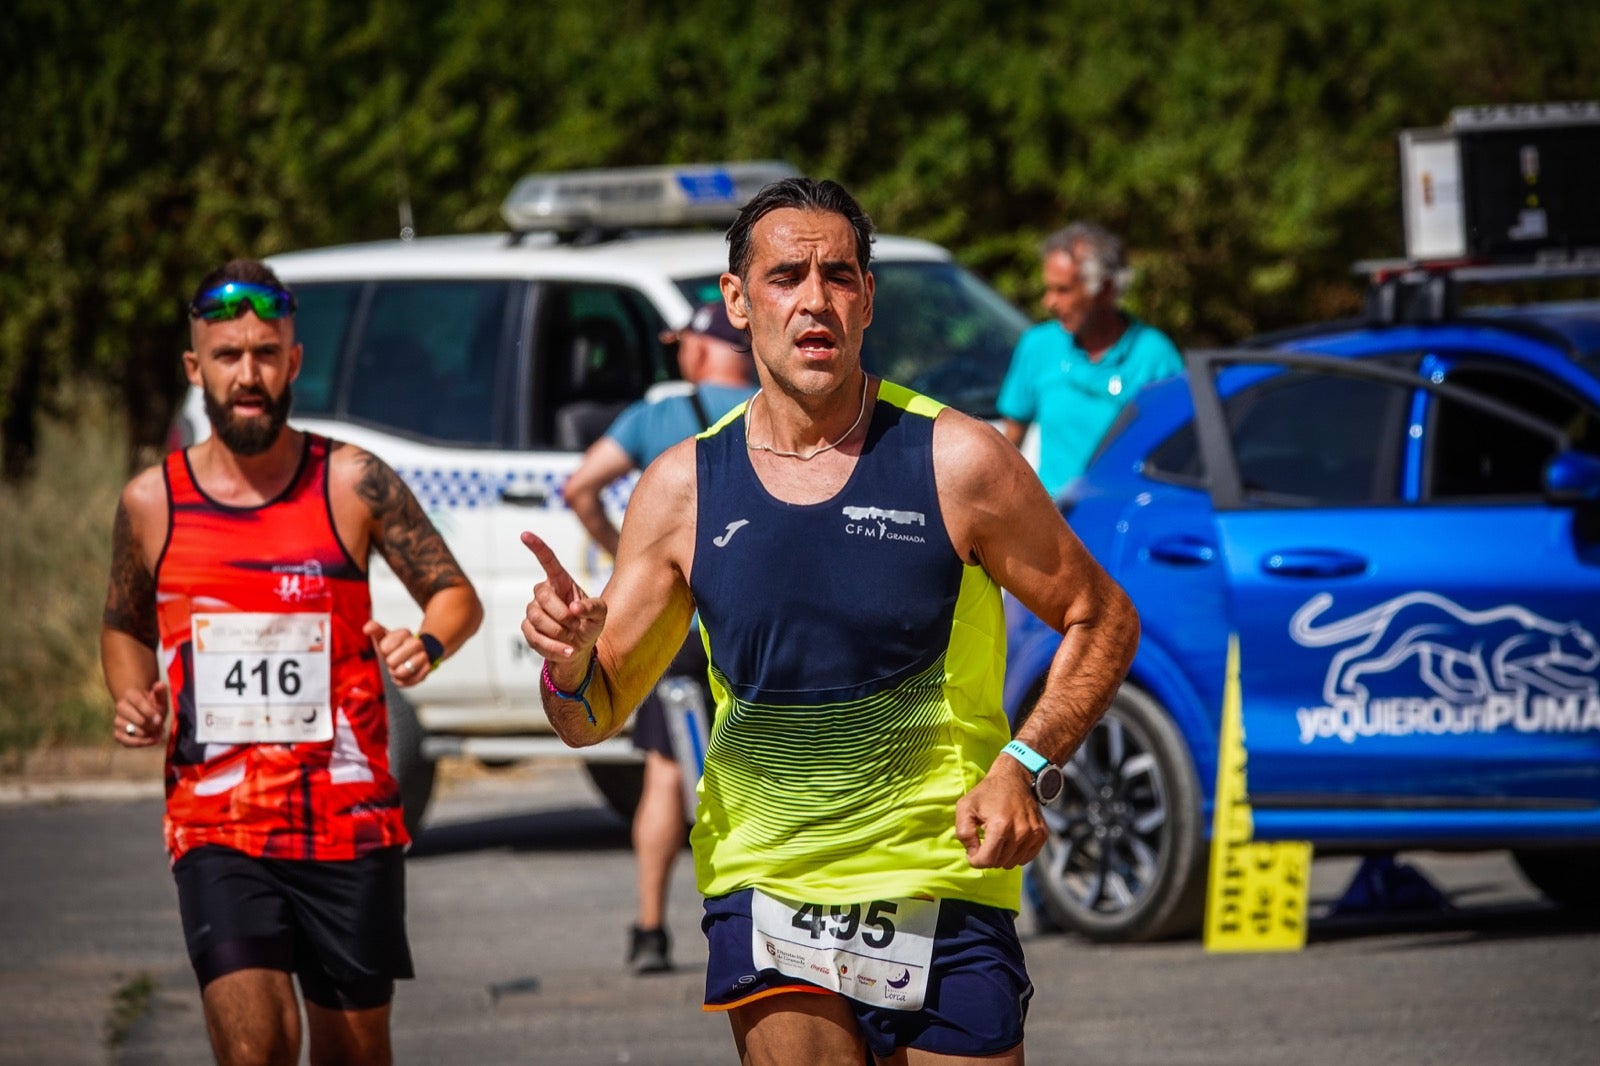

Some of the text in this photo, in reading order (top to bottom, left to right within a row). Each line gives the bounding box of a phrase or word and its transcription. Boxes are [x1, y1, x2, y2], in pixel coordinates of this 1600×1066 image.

[845, 523, 926, 544] CFM GRANADA
[224, 659, 302, 697] 416
[791, 899, 899, 950] 495
[884, 984, 907, 1002] Lorca
